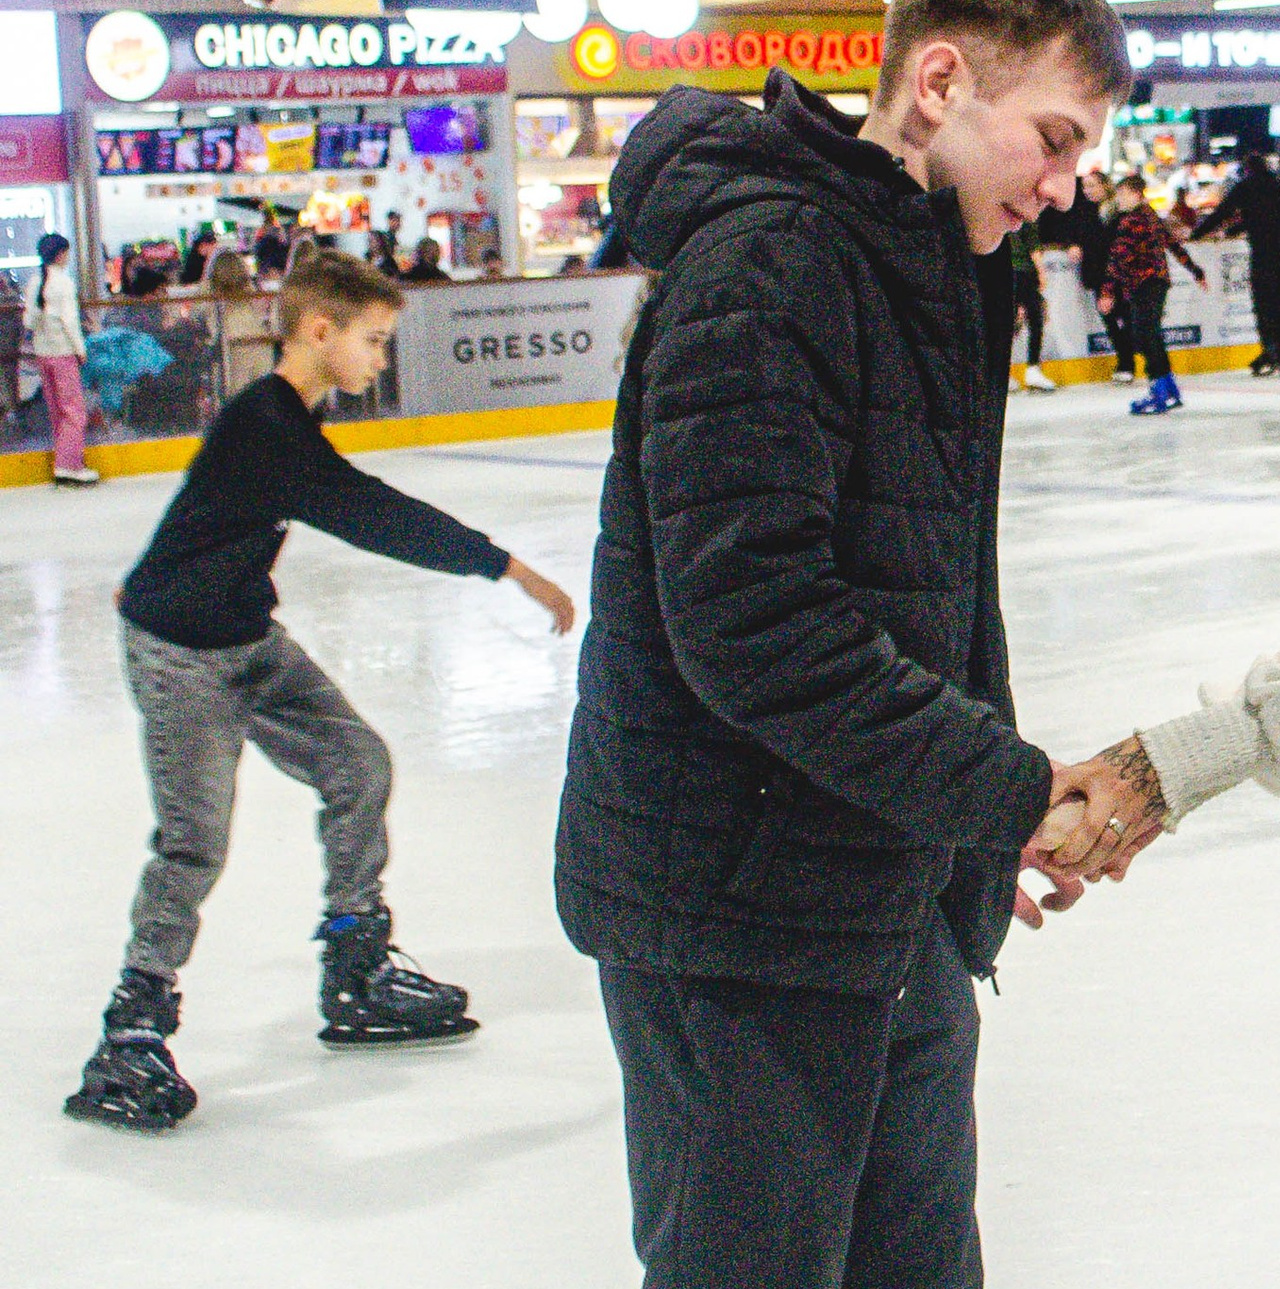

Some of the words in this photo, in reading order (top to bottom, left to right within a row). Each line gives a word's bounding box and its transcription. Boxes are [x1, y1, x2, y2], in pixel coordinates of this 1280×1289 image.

[195, 24, 384, 68] CHICAGO
[388, 23, 506, 66] PIZZA
[453, 330, 593, 364] GRESSO
